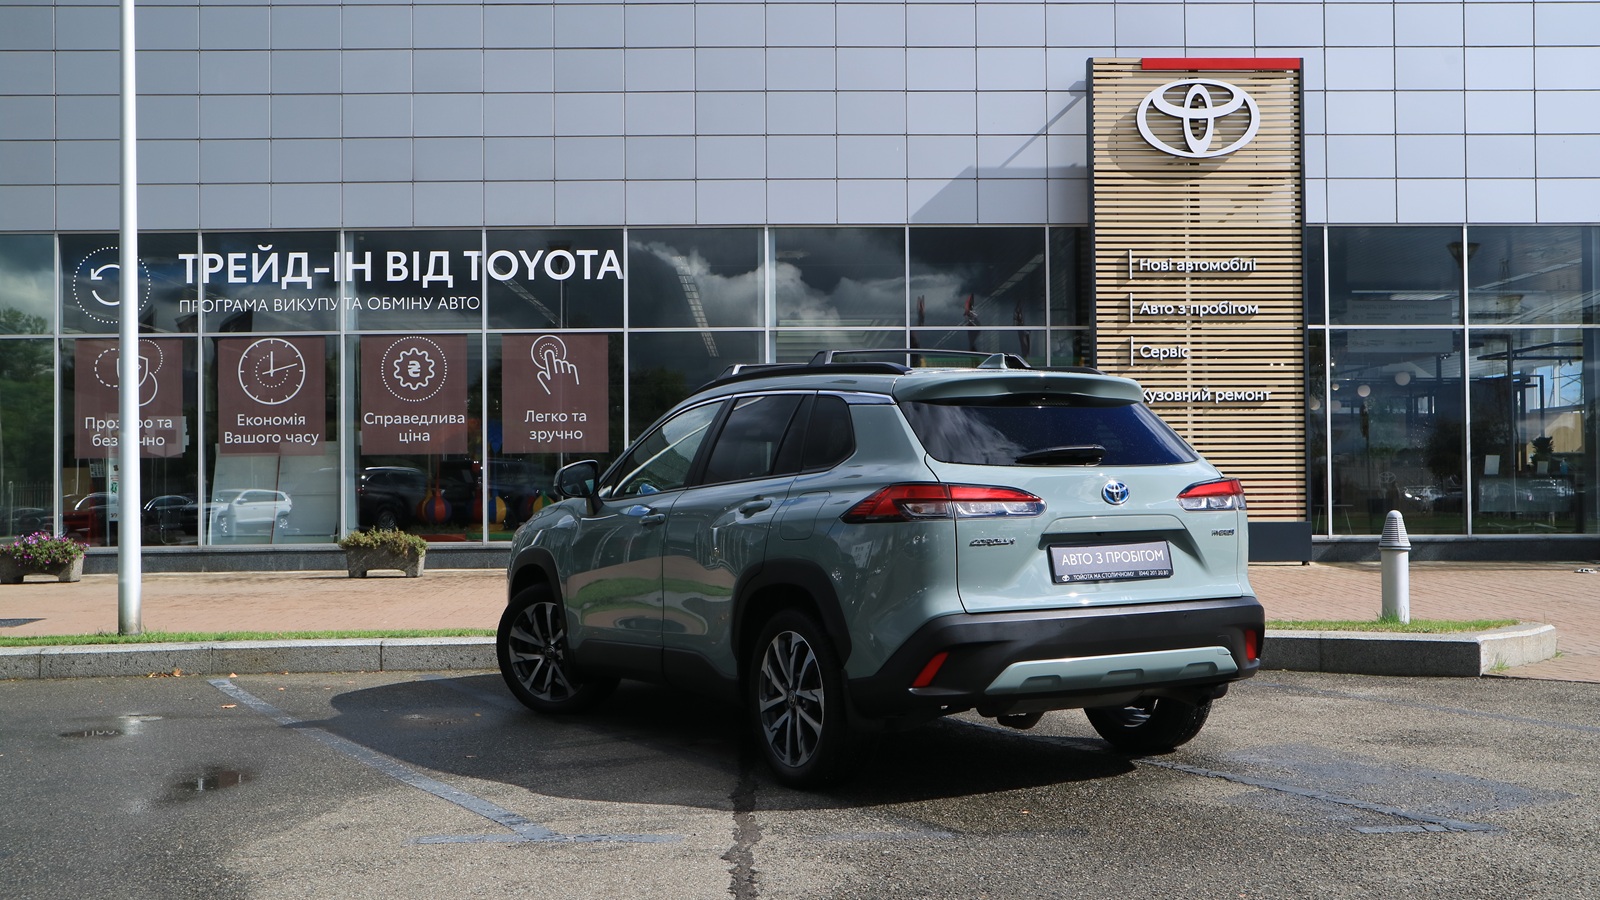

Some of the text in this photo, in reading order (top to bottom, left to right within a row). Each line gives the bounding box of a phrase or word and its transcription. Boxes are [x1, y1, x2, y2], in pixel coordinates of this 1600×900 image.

[178, 244, 624, 290] ТРЕЙД-ІН ВІД TOYOTA
[1140, 258, 1256, 271] Нові автомобілі
[179, 296, 480, 313] ПРОГРАМА ВИКУПУ ТА ОБМІНУ АВТО
[1140, 301, 1259, 317] Авто з пробігом
[1140, 345, 1190, 361] Сервіс
[1143, 388, 1271, 404] Кузовний ремонт
[157, 418, 173, 429] та
[236, 413, 306, 426] Економія
[363, 412, 466, 427] Справедлива
[525, 410, 587, 423] Легко та
[92, 433, 165, 447] безчно
[224, 431, 320, 446] Вашого часу
[399, 430, 430, 444] ціна
[529, 430, 583, 443] зручно
[1062, 553, 1092, 566] АВТО
[1105, 549, 1165, 563] ПРОБІГОМ
